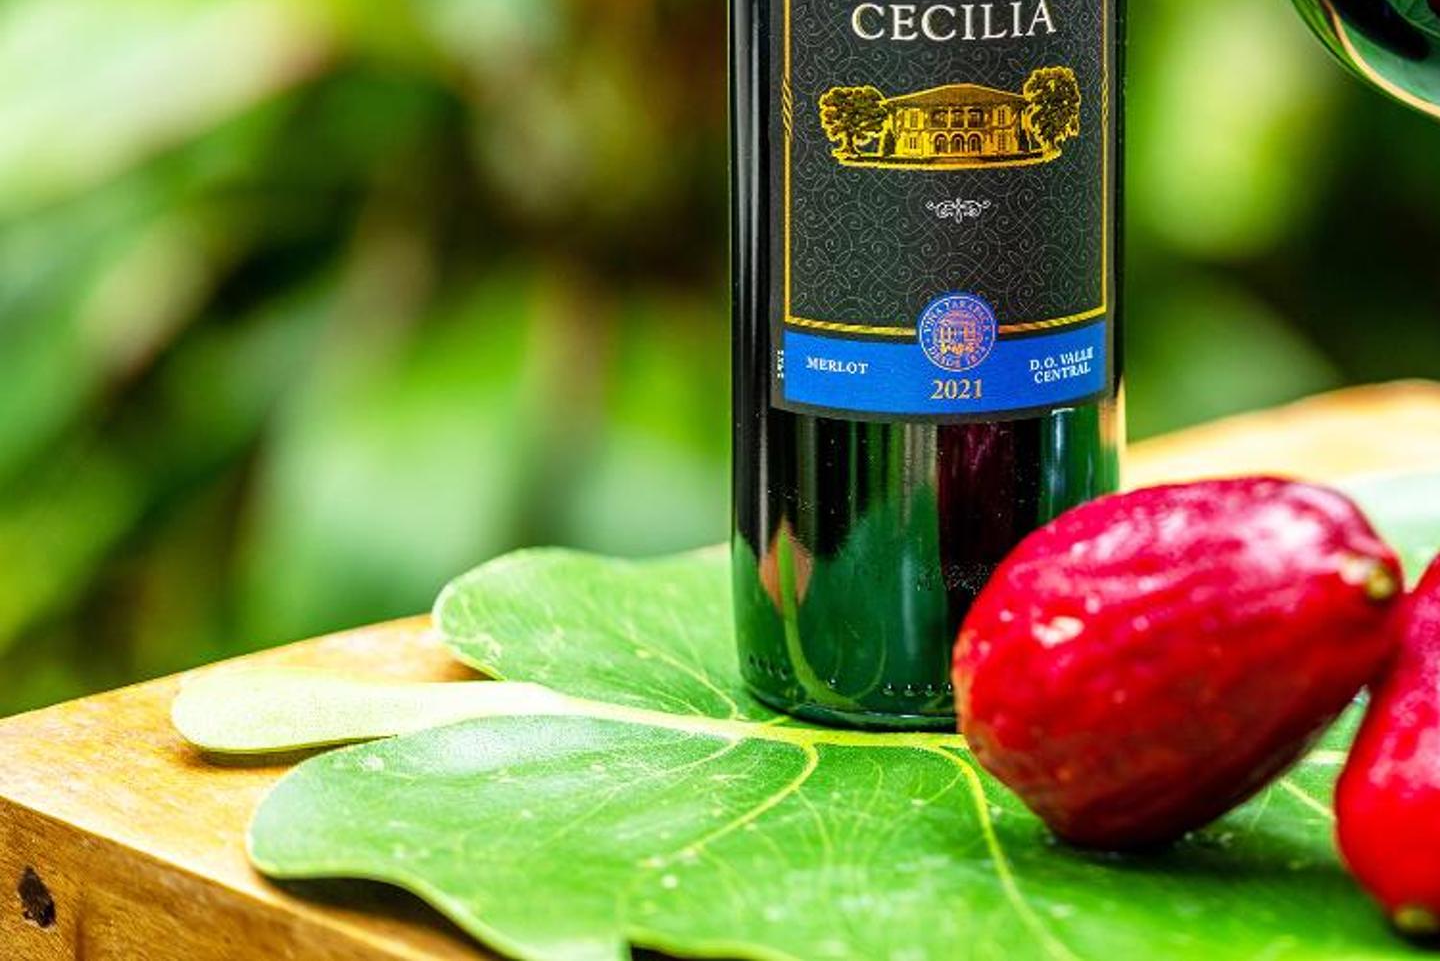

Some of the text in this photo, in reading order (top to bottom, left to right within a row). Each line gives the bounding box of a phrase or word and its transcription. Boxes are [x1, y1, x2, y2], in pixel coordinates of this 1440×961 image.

[806, 355, 869, 375] MERLOT
[1029, 346, 1094, 371] D.O. VALLE
[1034, 361, 1092, 384] CENTRAL
[930, 378, 983, 399] 2021
